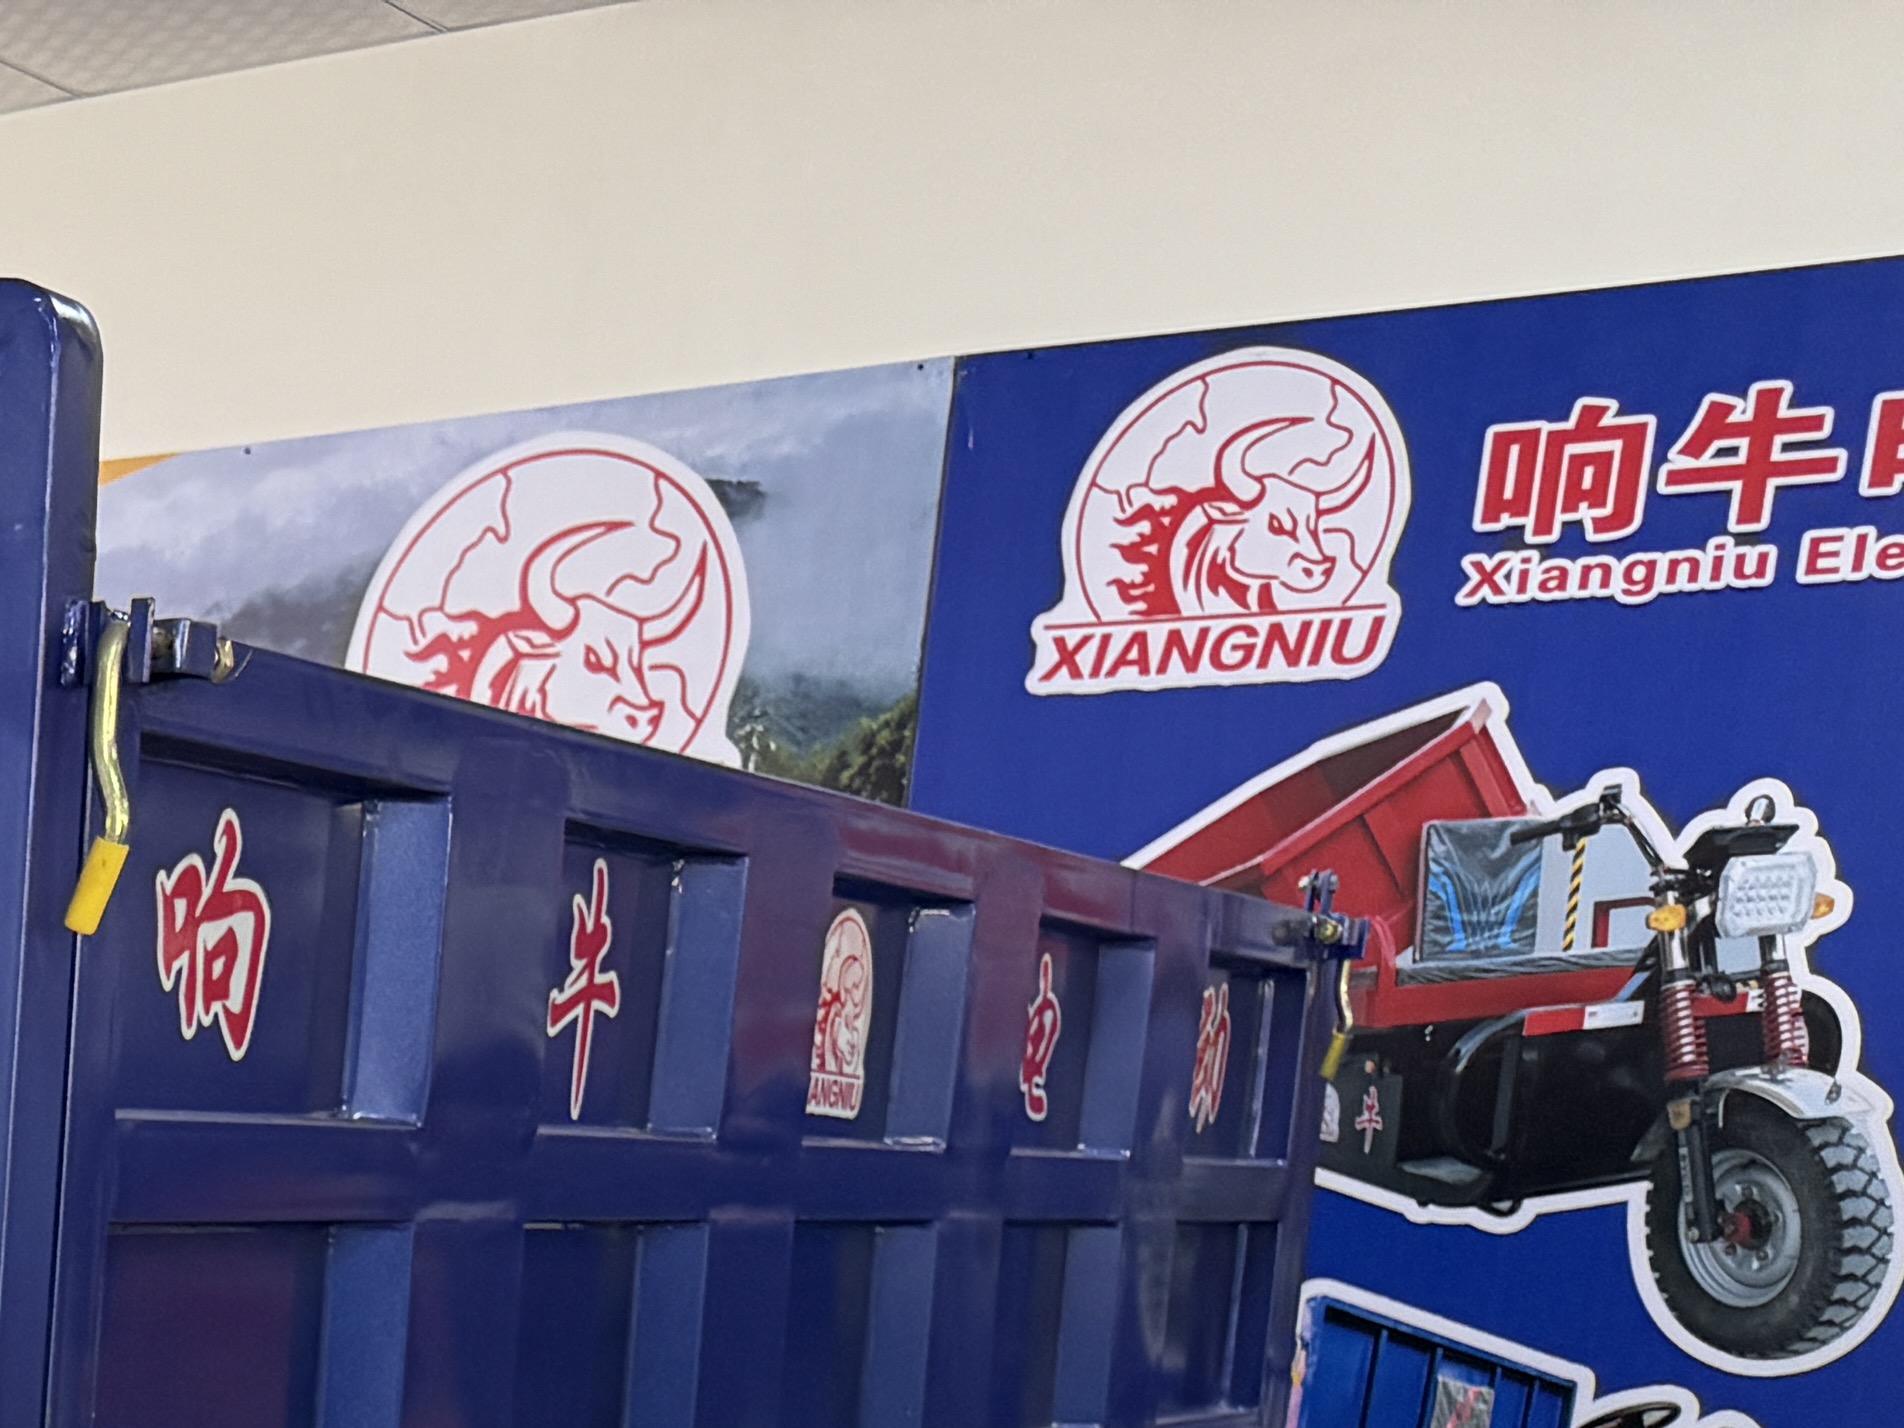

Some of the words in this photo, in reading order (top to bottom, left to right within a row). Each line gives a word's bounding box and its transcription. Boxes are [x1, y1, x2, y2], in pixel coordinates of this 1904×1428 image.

[1478, 384, 1904, 538] 响牛
[1460, 541, 1772, 600] Xiangniu
[1803, 532, 1904, 577] Ele
[1038, 614, 1387, 682] XIANGNIU
[156, 810, 271, 1060] 响
[548, 860, 620, 1120] 牛
[807, 1076, 858, 1112] ANGNIU
